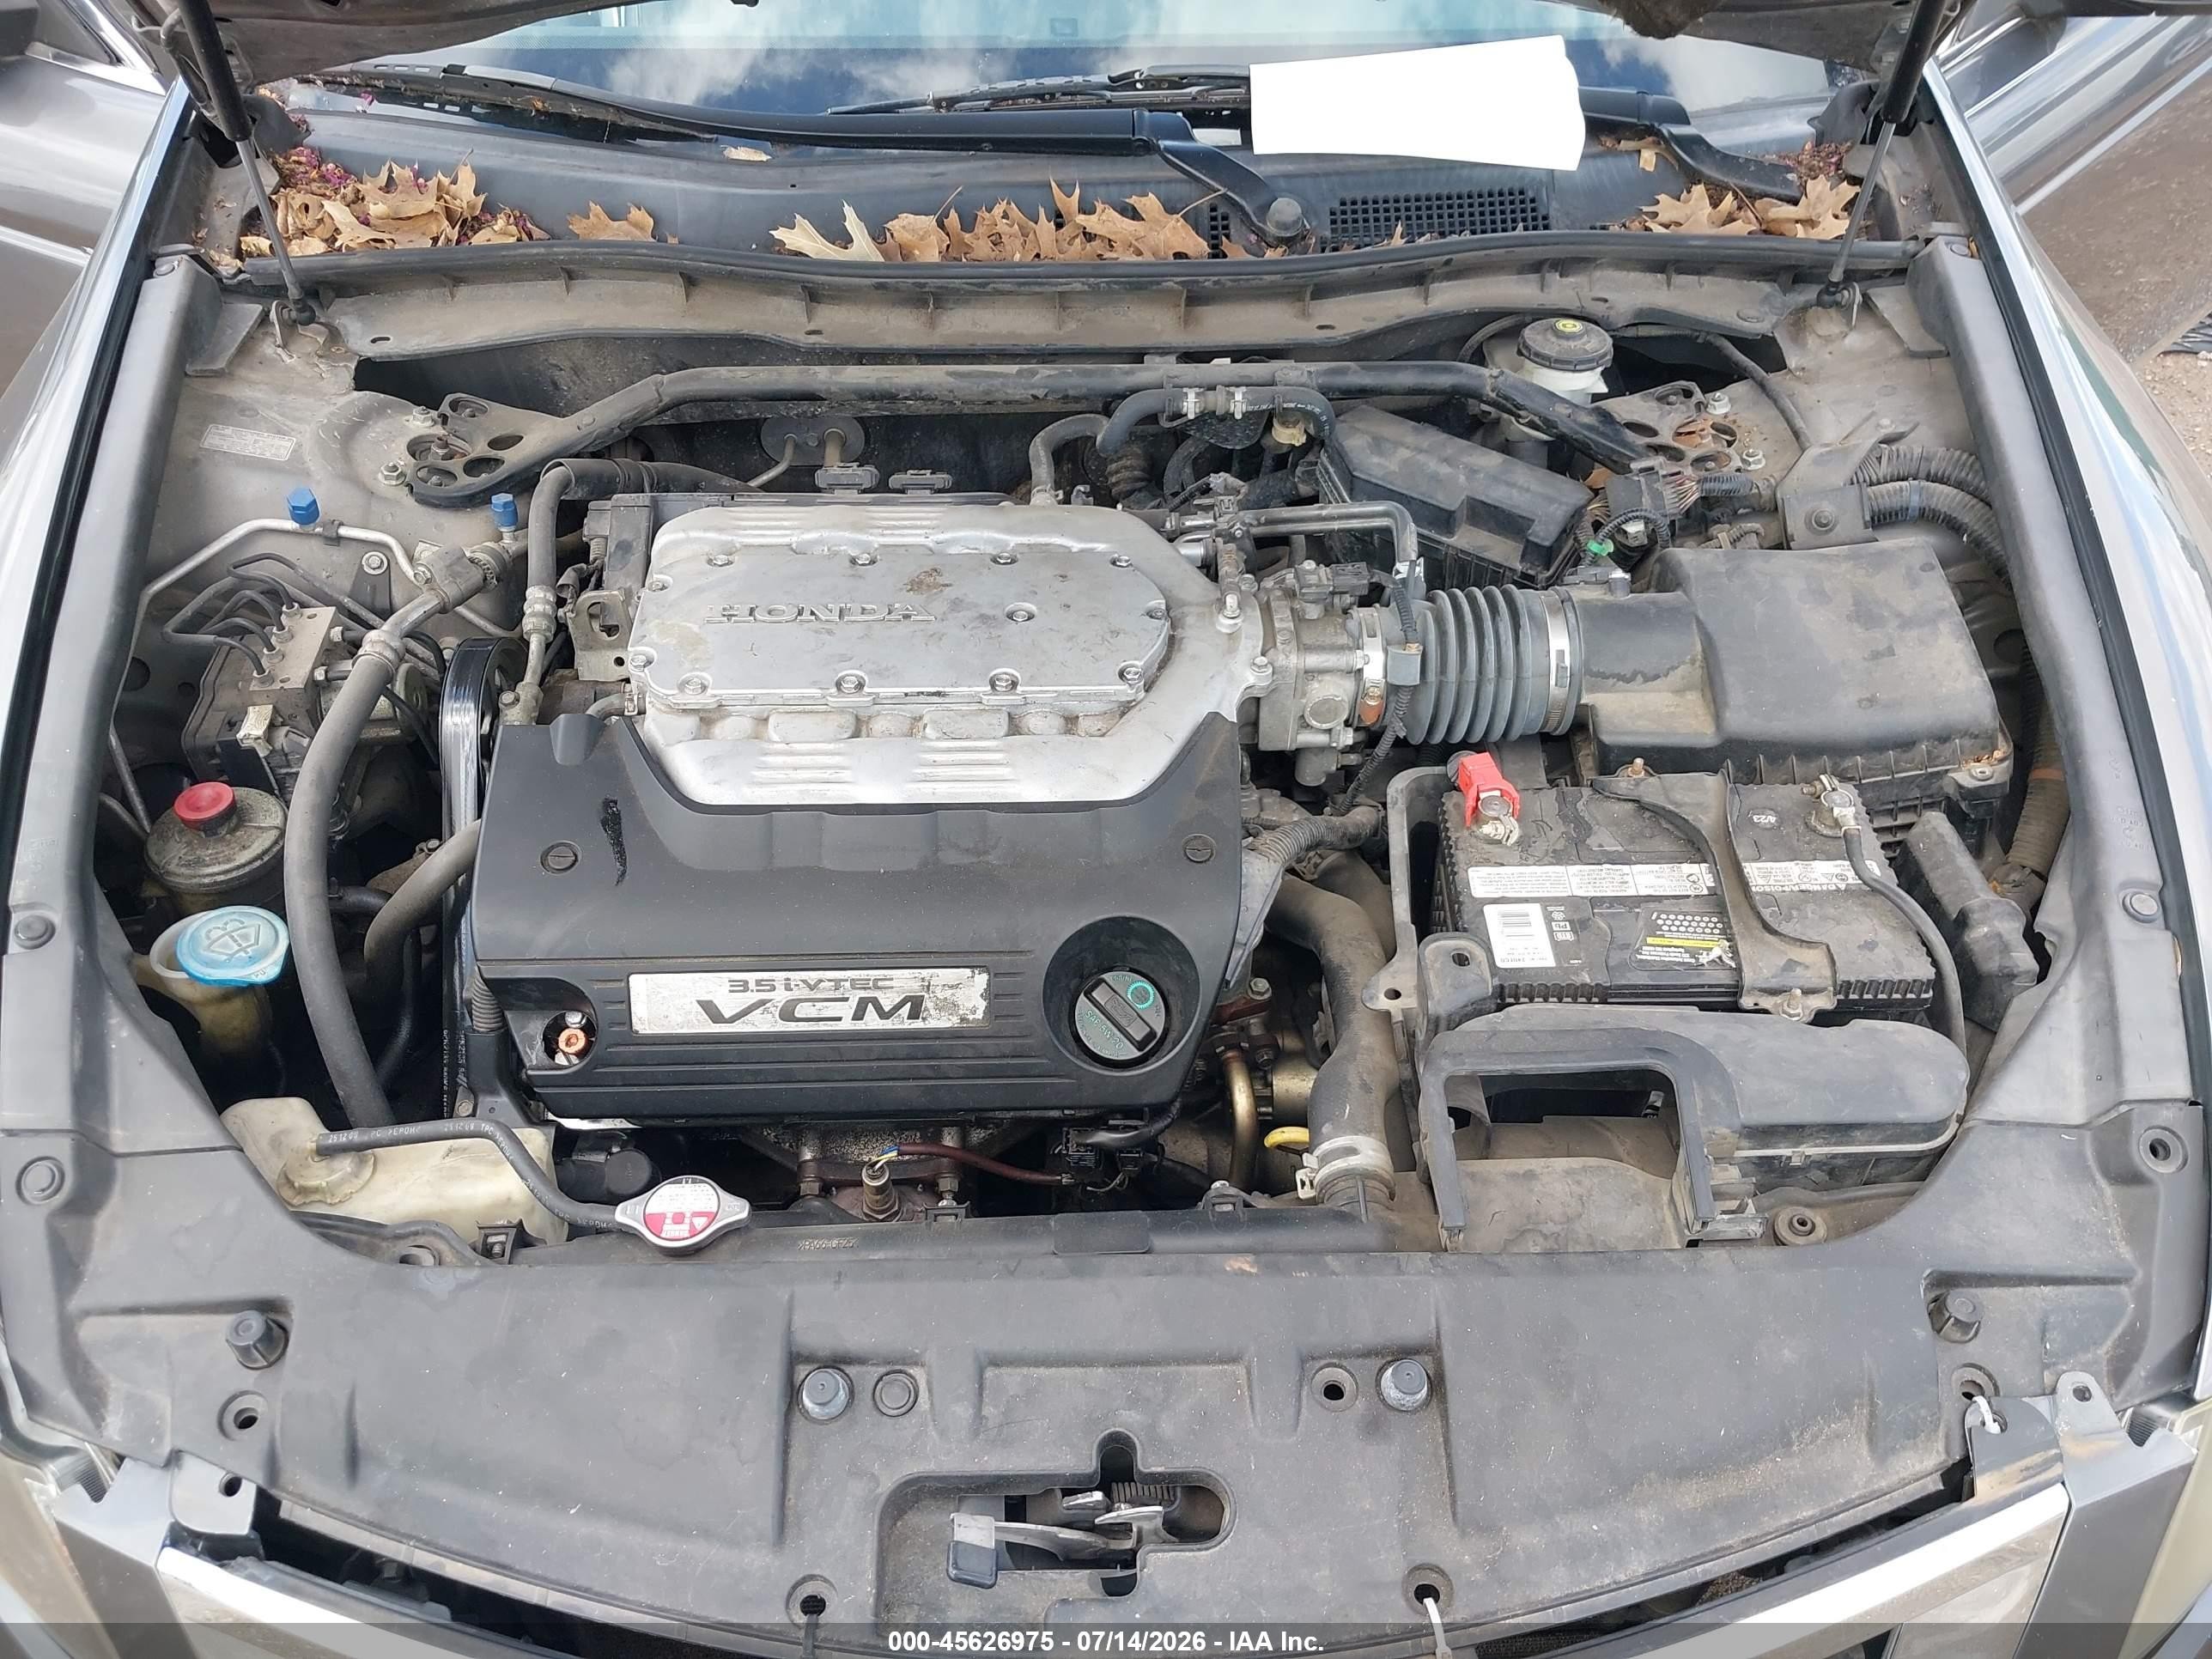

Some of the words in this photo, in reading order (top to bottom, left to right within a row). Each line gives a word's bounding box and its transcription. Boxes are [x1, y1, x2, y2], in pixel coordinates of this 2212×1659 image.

[704, 603, 936, 623] HONDA
[728, 978, 777, 994] 3.5
[783, 977, 895, 992] i-VTEC
[696, 994, 927, 1025] VCM
[1085, 1010, 1102, 1026] SAE
